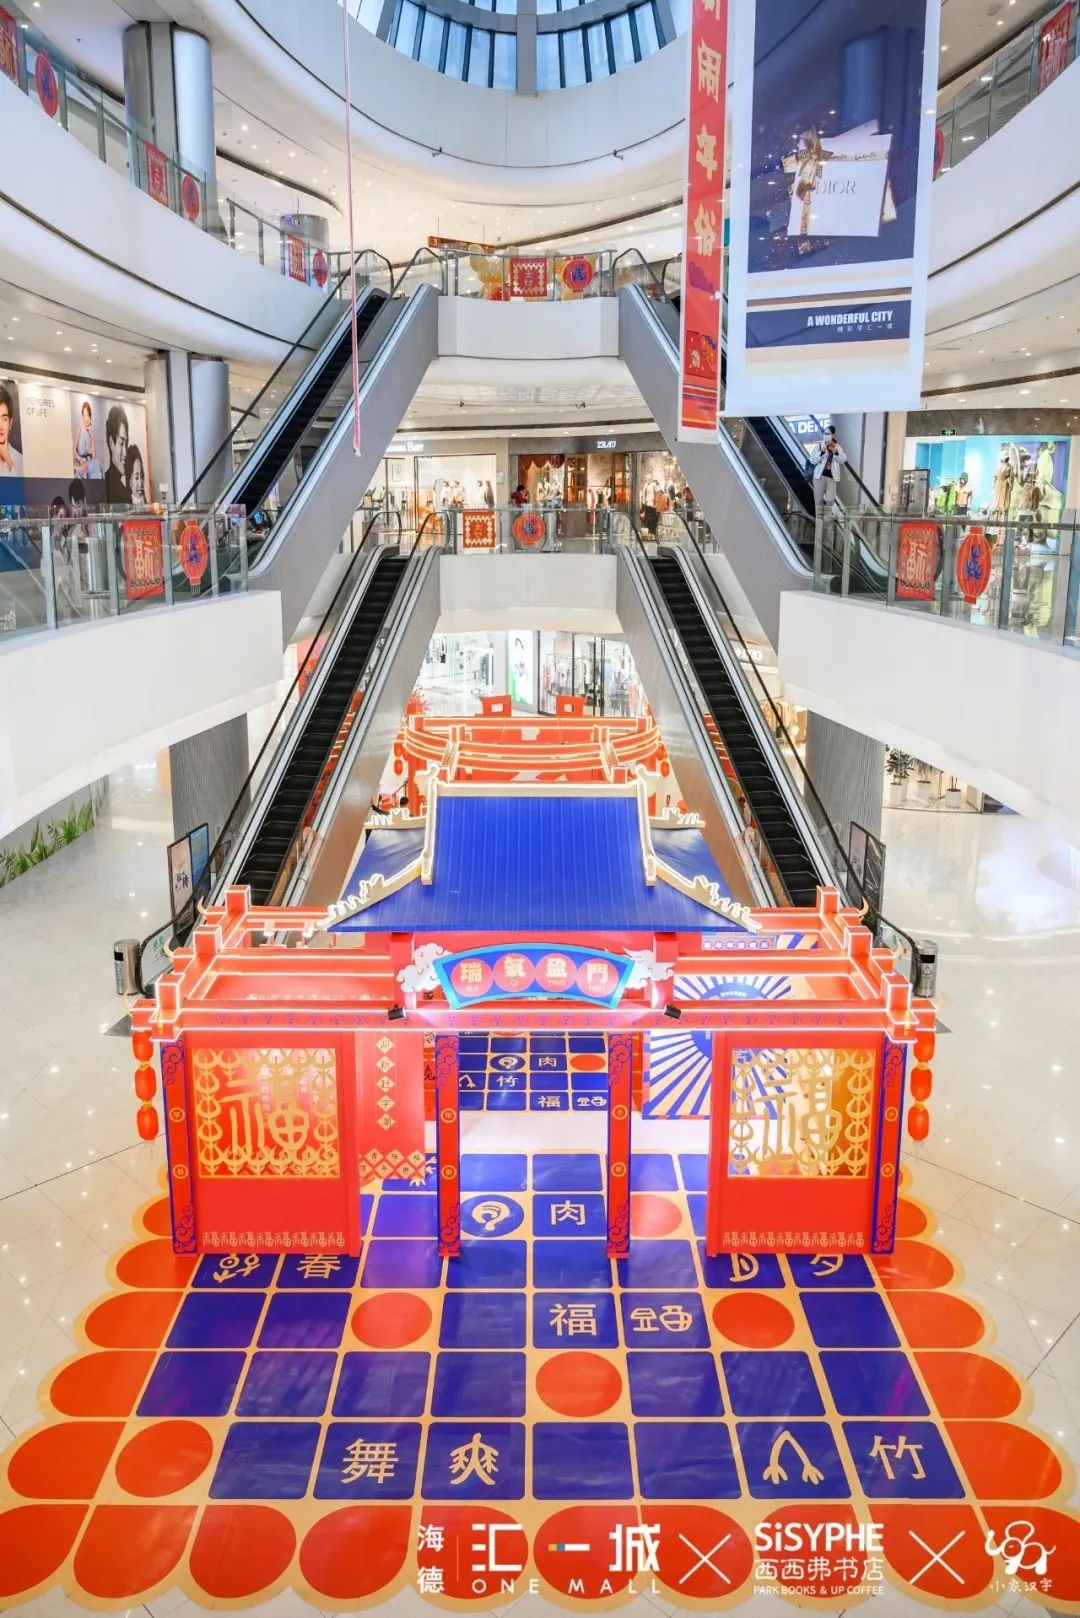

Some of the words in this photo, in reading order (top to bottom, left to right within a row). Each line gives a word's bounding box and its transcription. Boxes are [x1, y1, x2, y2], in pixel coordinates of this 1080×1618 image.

[807, 316, 814, 327] A
[815, 312, 869, 326] WONDERFUL
[871, 311, 893, 322] CITY
[26, 397, 56, 408] EORIES
[538, 1056, 558, 1068] 肉
[537, 1095, 561, 1108] 福
[550, 1200, 586, 1226] 肉
[296, 1253, 342, 1279] 春
[549, 1303, 598, 1337] 福
[340, 1438, 399, 1484] 舞
[868, 1435, 924, 1480] 竹
